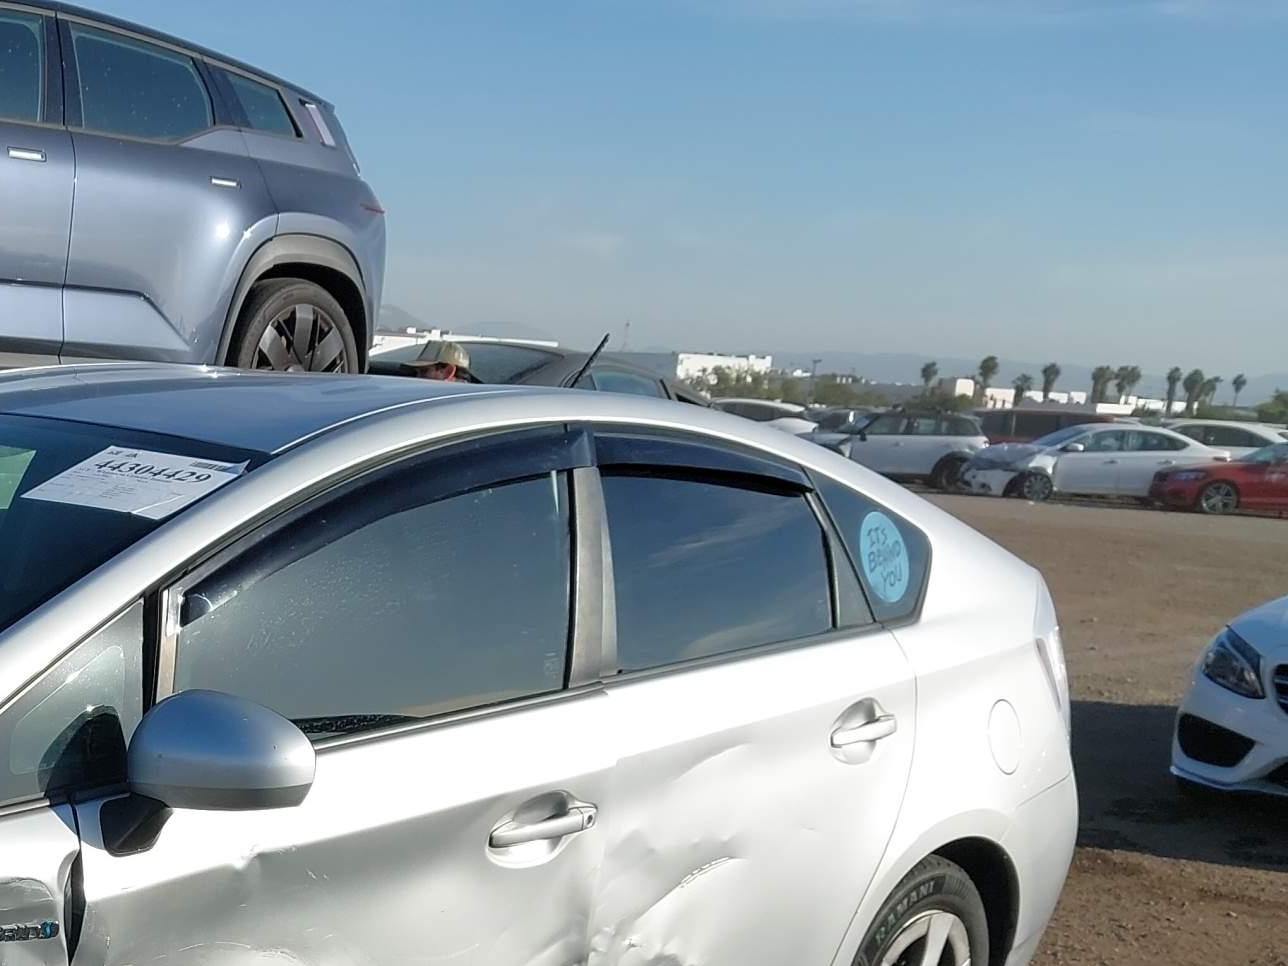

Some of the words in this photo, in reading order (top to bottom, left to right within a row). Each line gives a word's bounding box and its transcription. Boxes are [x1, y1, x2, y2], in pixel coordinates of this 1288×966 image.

[94, 459, 212, 483] 44304429
[867, 528, 888, 547] ITS
[880, 562, 903, 593] YOU
